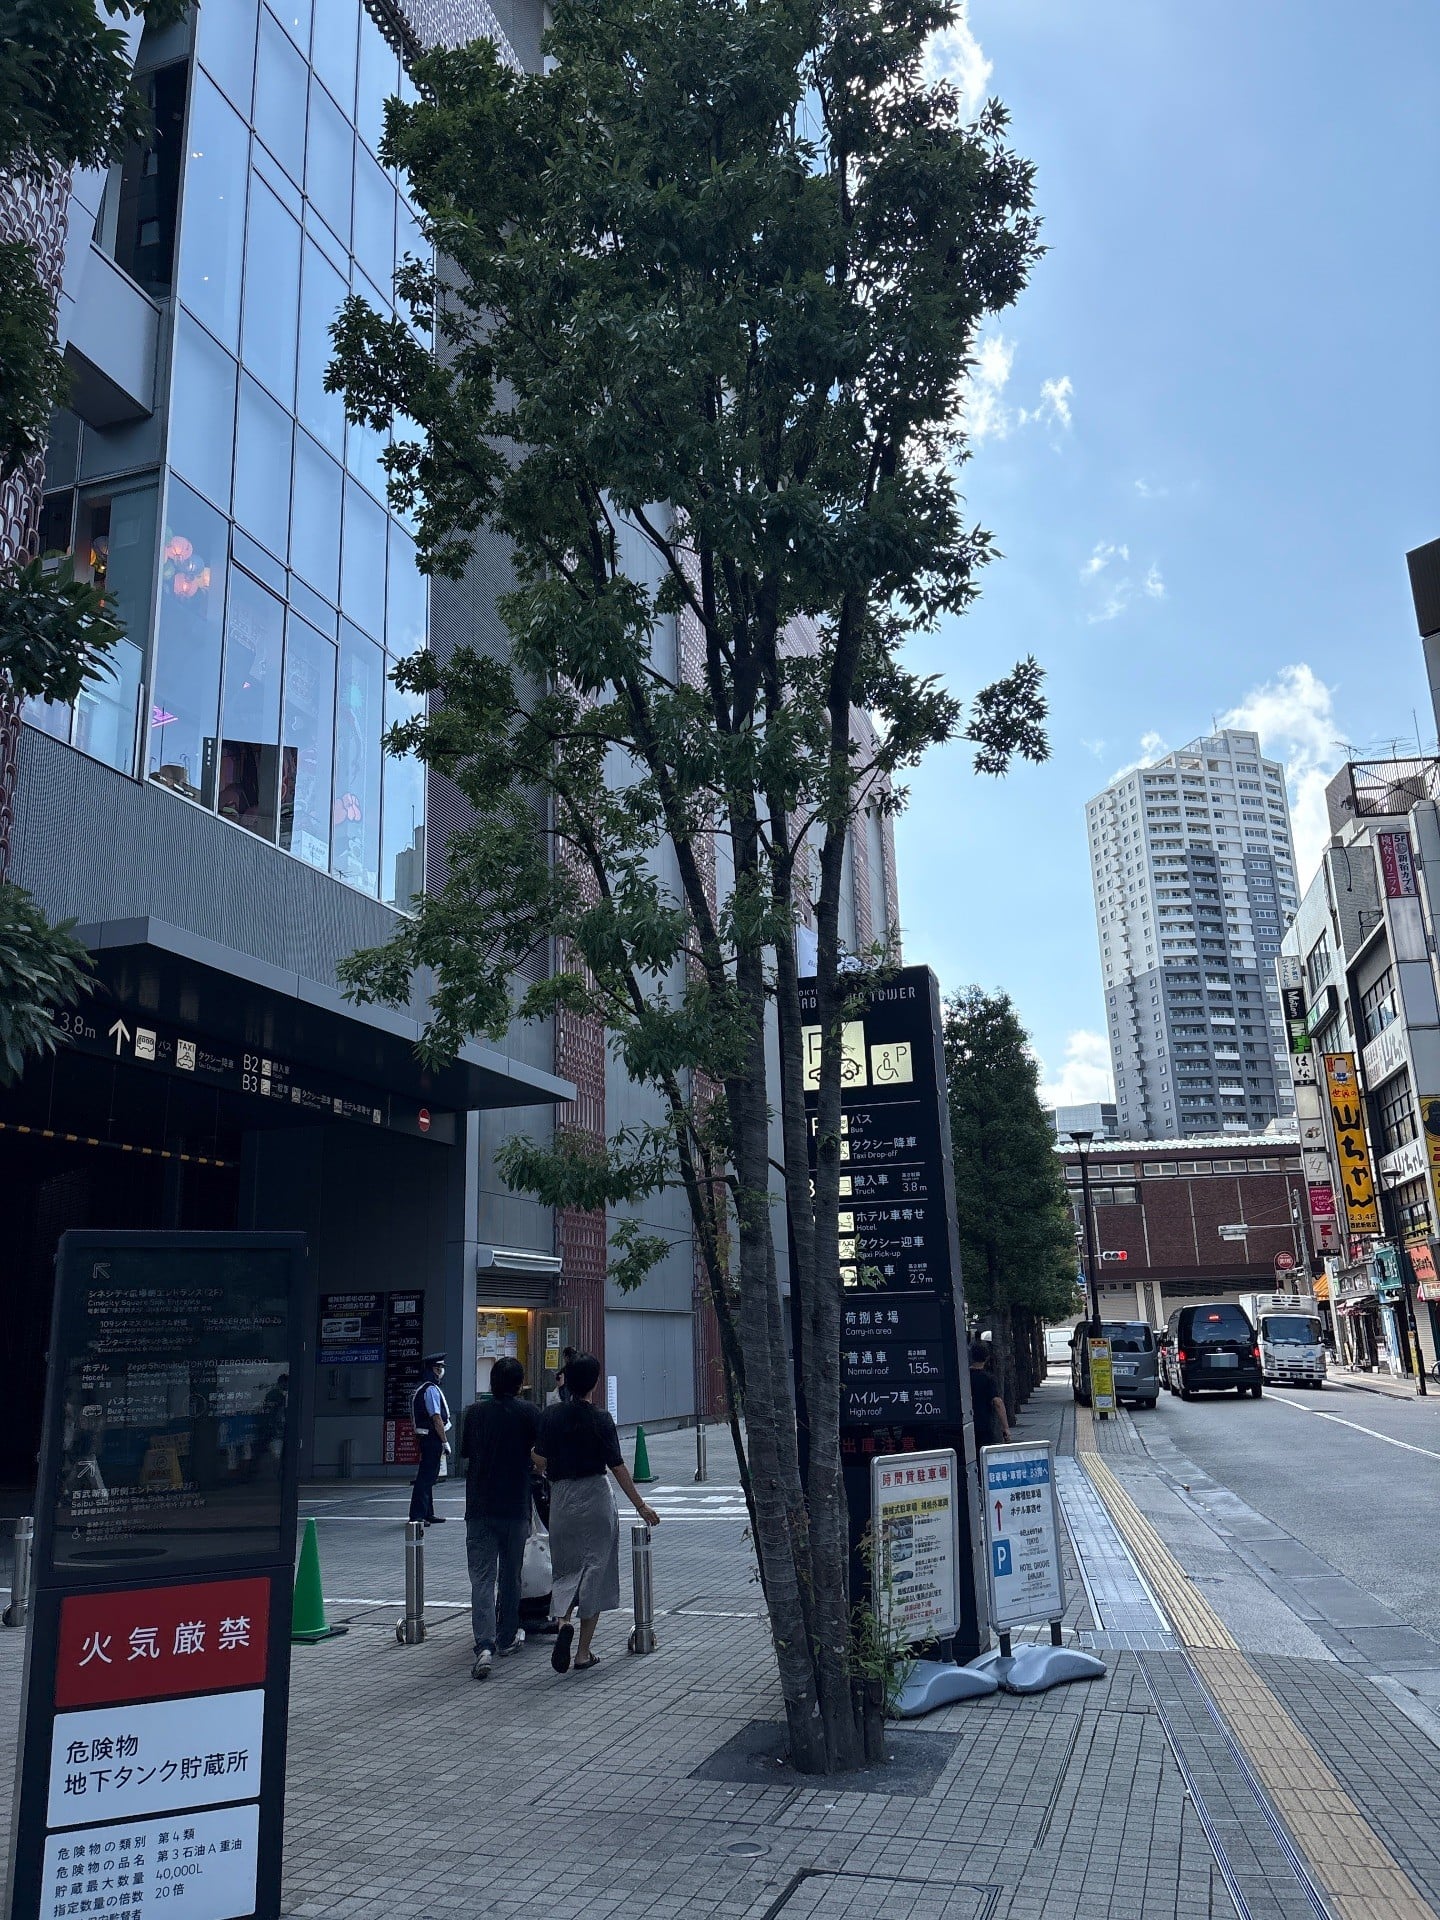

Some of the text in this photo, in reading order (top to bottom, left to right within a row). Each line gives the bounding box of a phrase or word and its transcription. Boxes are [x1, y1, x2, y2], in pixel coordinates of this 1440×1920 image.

[1394, 834, 1406, 843] 5F
[158, 1041, 171, 1051] バス
[243, 1054, 259, 1073] B2
[242, 1074, 258, 1093] B3
[851, 1114, 872, 1124] バス
[851, 1136, 917, 1151] タクシー降車
[1333, 1104, 1374, 1208] 山ちゃん
[854, 1174, 889, 1187] 搬入車
[856, 1208, 925, 1223] ホテル車寄せ
[858, 1236, 925, 1249] タクシー迎車
[874, 1250, 901, 1258] Pick-up
[845, 1311, 899, 1325] 荷捌き場
[845, 1328, 874, 1336] Carry-in
[848, 1351, 887, 1364] 普通車
[82, 1364, 110, 1372] ホテル
[847, 1366, 890, 1376] Normal roof
[849, 1391, 909, 1404] ハイルーフ車
[849, 1407, 882, 1417] High roof
[882, 1466, 947, 1486] 時間貸駐車場
[79, 1615, 251, 1667] 火気厳禁
[66, 1733, 139, 1765] 危険物
[63, 1749, 249, 1796] 地下タンク貯蔵所
[57, 1835, 146, 1861] 危険物の類別
[56, 1854, 146, 1881] 危険物の品名
[54, 1863, 203, 1899] 貯蔵最大数量 40,000L
[53, 1890, 144, 1918] 指定数量の倍数
